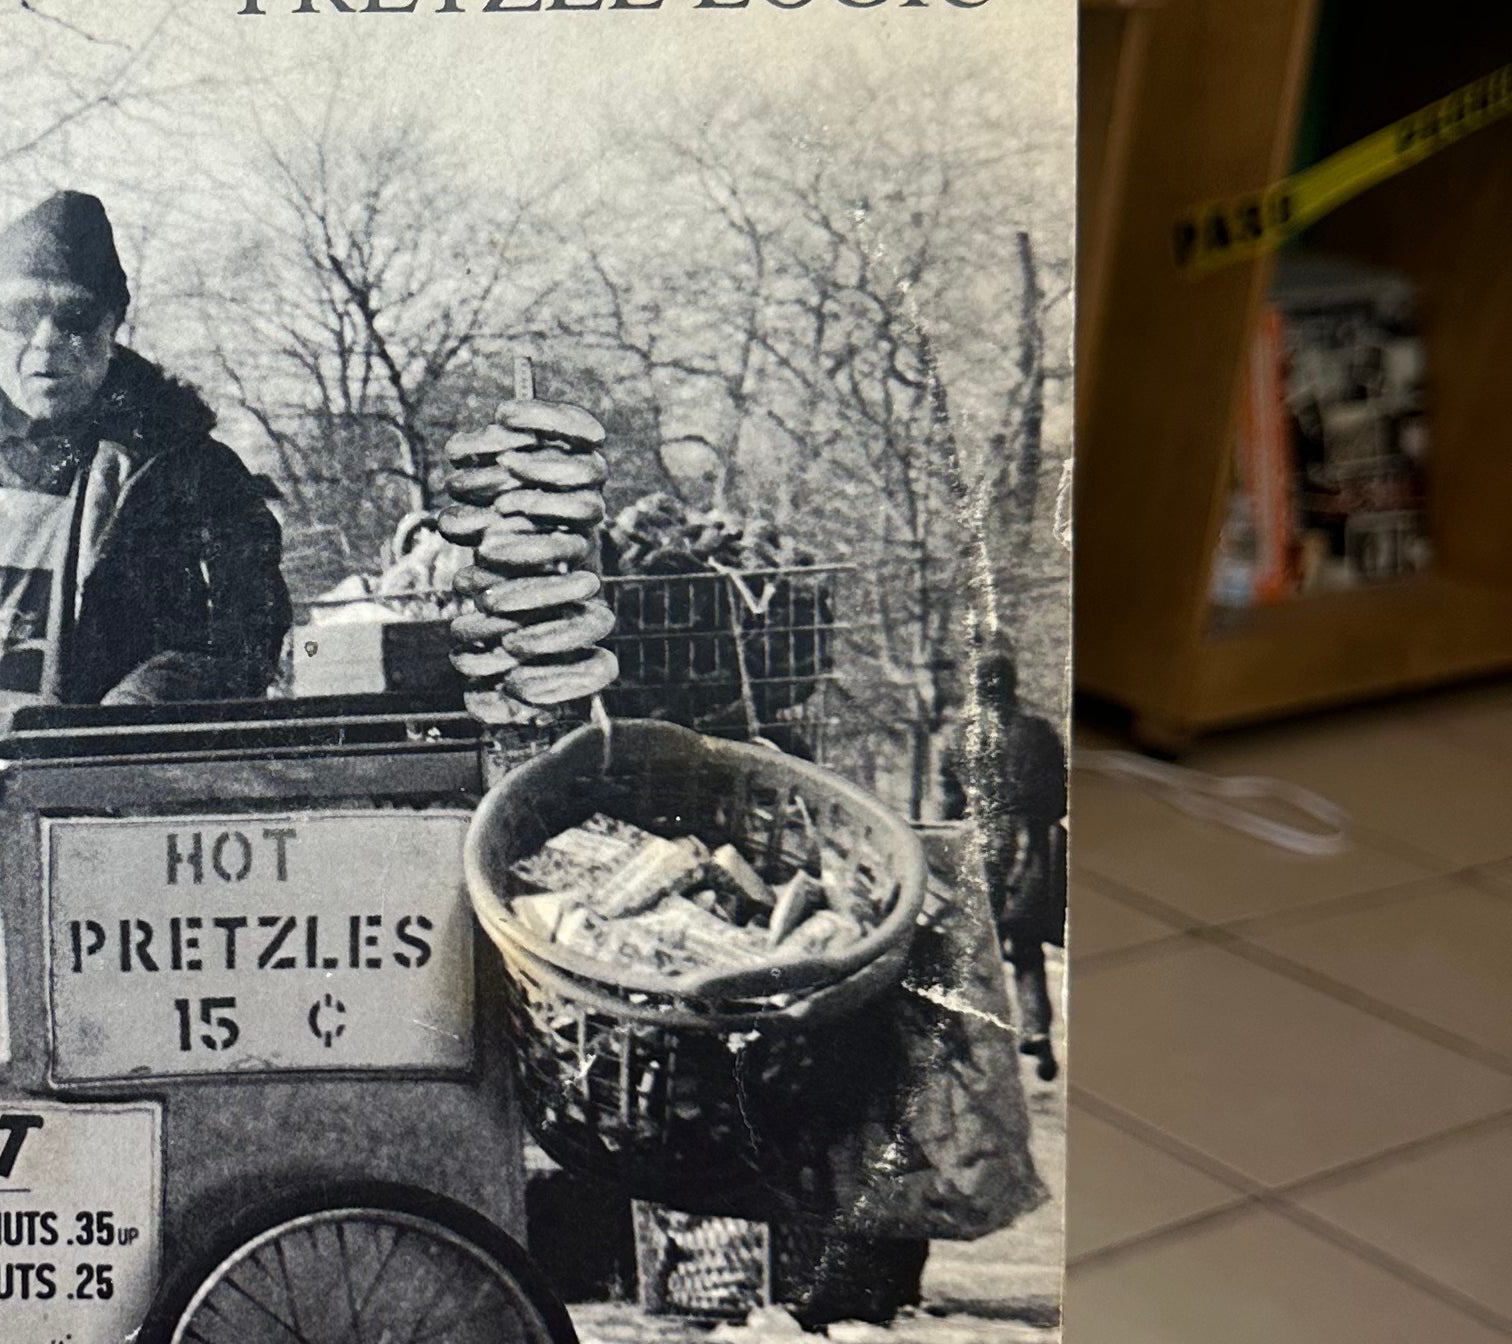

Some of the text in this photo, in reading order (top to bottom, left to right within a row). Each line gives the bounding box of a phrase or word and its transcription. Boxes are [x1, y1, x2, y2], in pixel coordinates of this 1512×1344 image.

[166, 827, 297, 886] HOT
[69, 914, 434, 974] PRETZLES
[174, 996, 240, 1052] 15
[66, 1262, 115, 1301] .25
